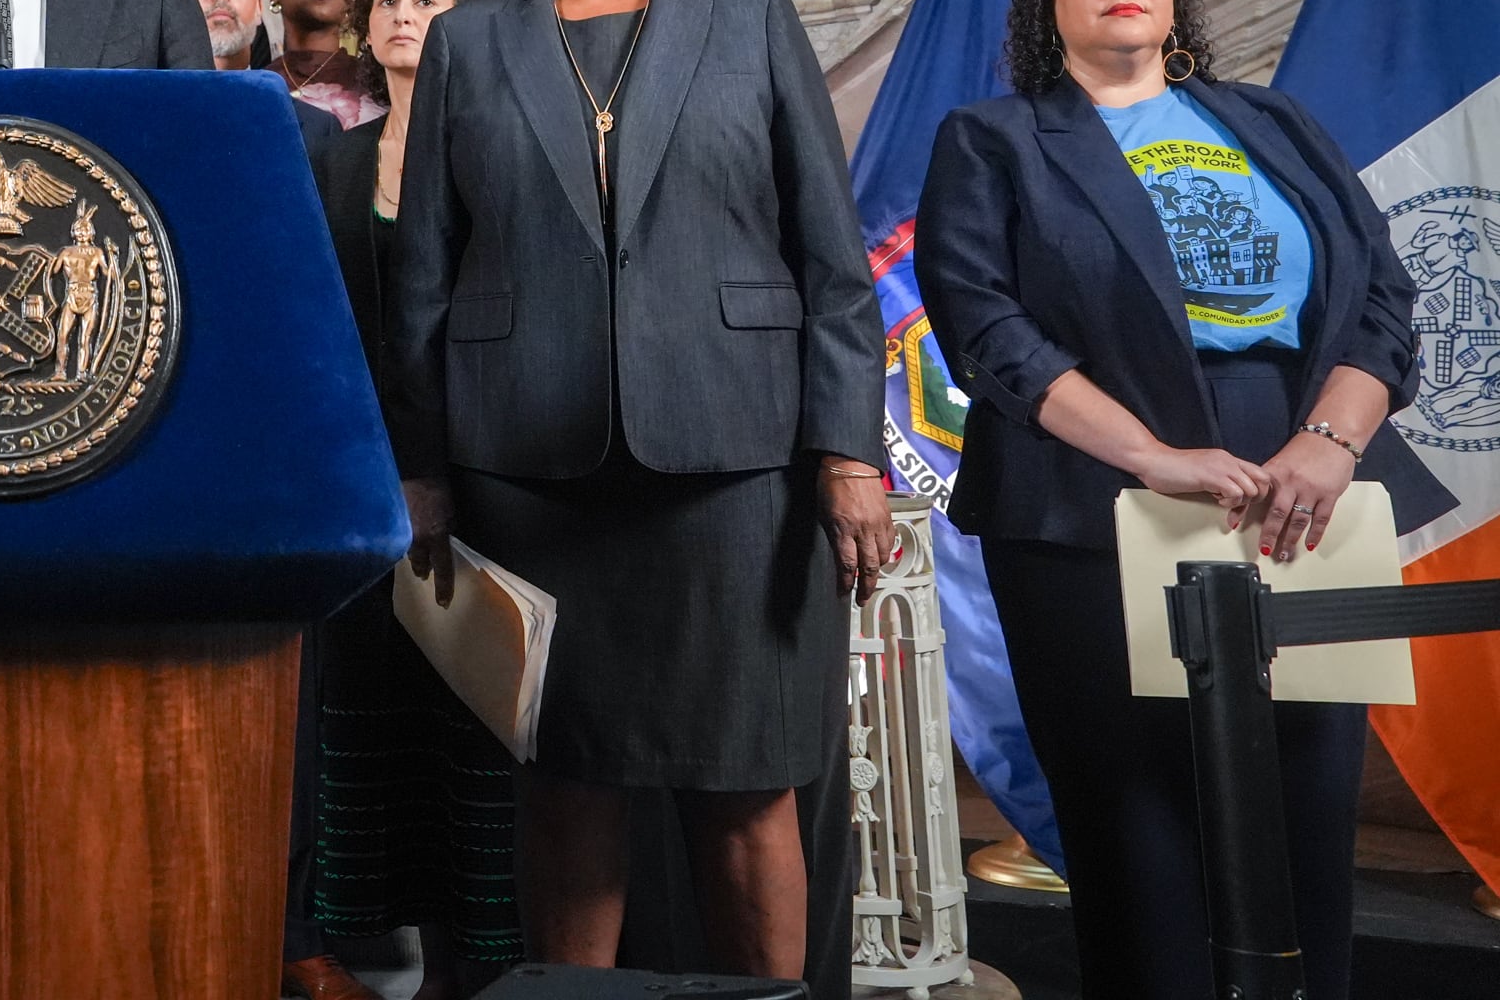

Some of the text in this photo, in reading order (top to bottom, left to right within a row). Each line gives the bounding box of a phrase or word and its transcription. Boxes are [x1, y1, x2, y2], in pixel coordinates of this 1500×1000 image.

[1142, 144, 1180, 158] THE
[1183, 144, 1241, 161] ROAD
[1160, 156, 1241, 170] NEW YORK
[1198, 311, 1246, 325] COMUNIDAD
[1255, 312, 1280, 324] PODER
[884, 419, 951, 509] ELSIOR
